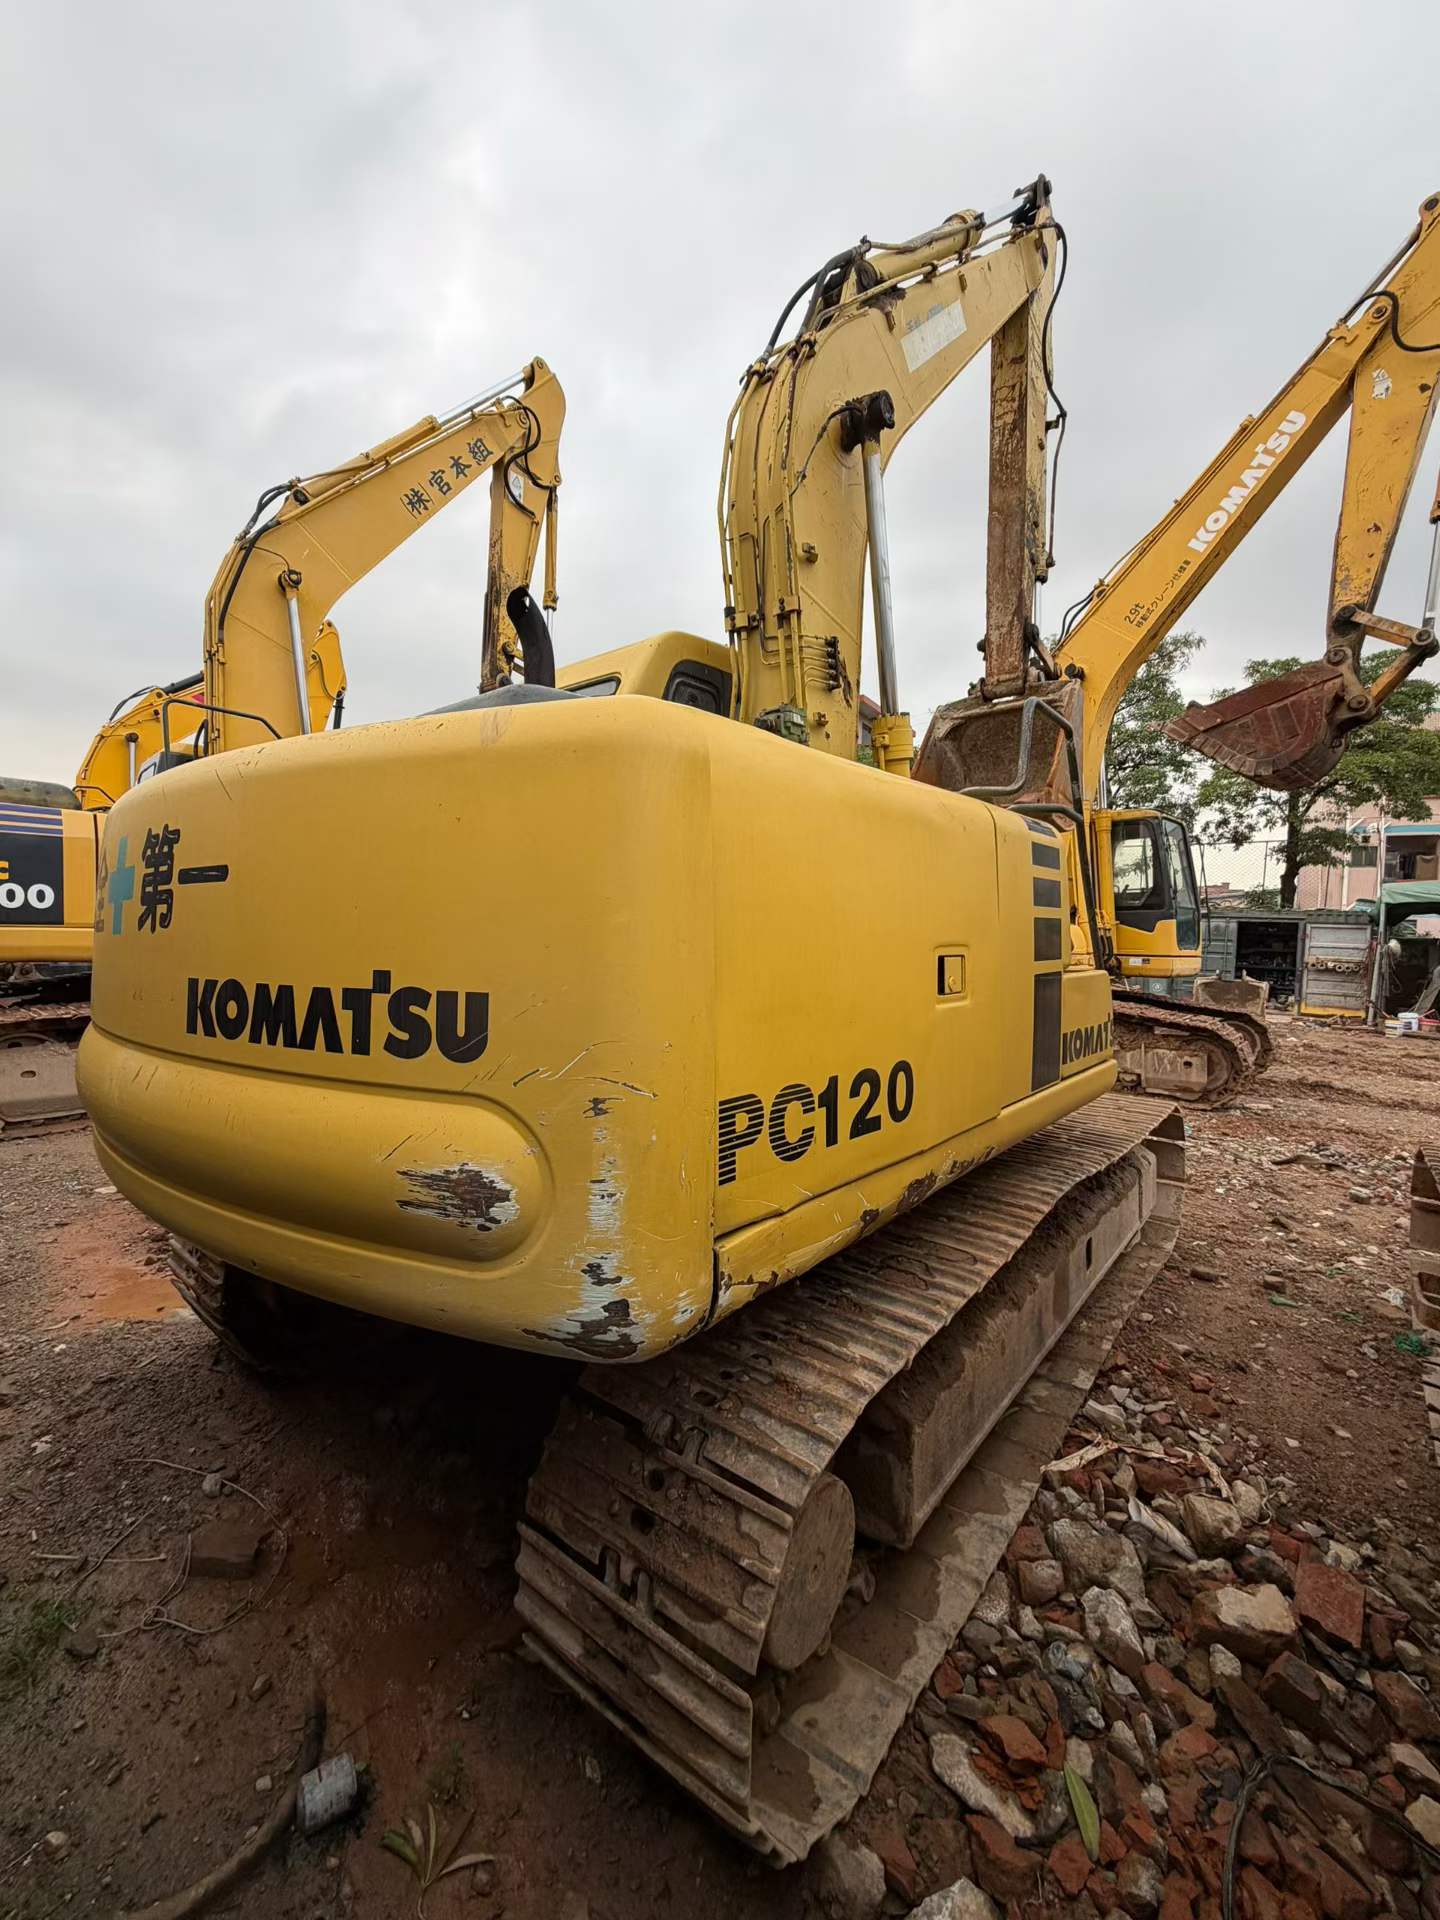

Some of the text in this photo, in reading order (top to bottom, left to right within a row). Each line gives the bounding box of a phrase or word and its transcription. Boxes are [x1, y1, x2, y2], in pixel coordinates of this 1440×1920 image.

[1187, 410, 1307, 553] KOMATSU
[137, 823, 229, 935] 第一
[186, 969, 490, 1064] KOMATSU
[718, 1059, 914, 1186] PC120
